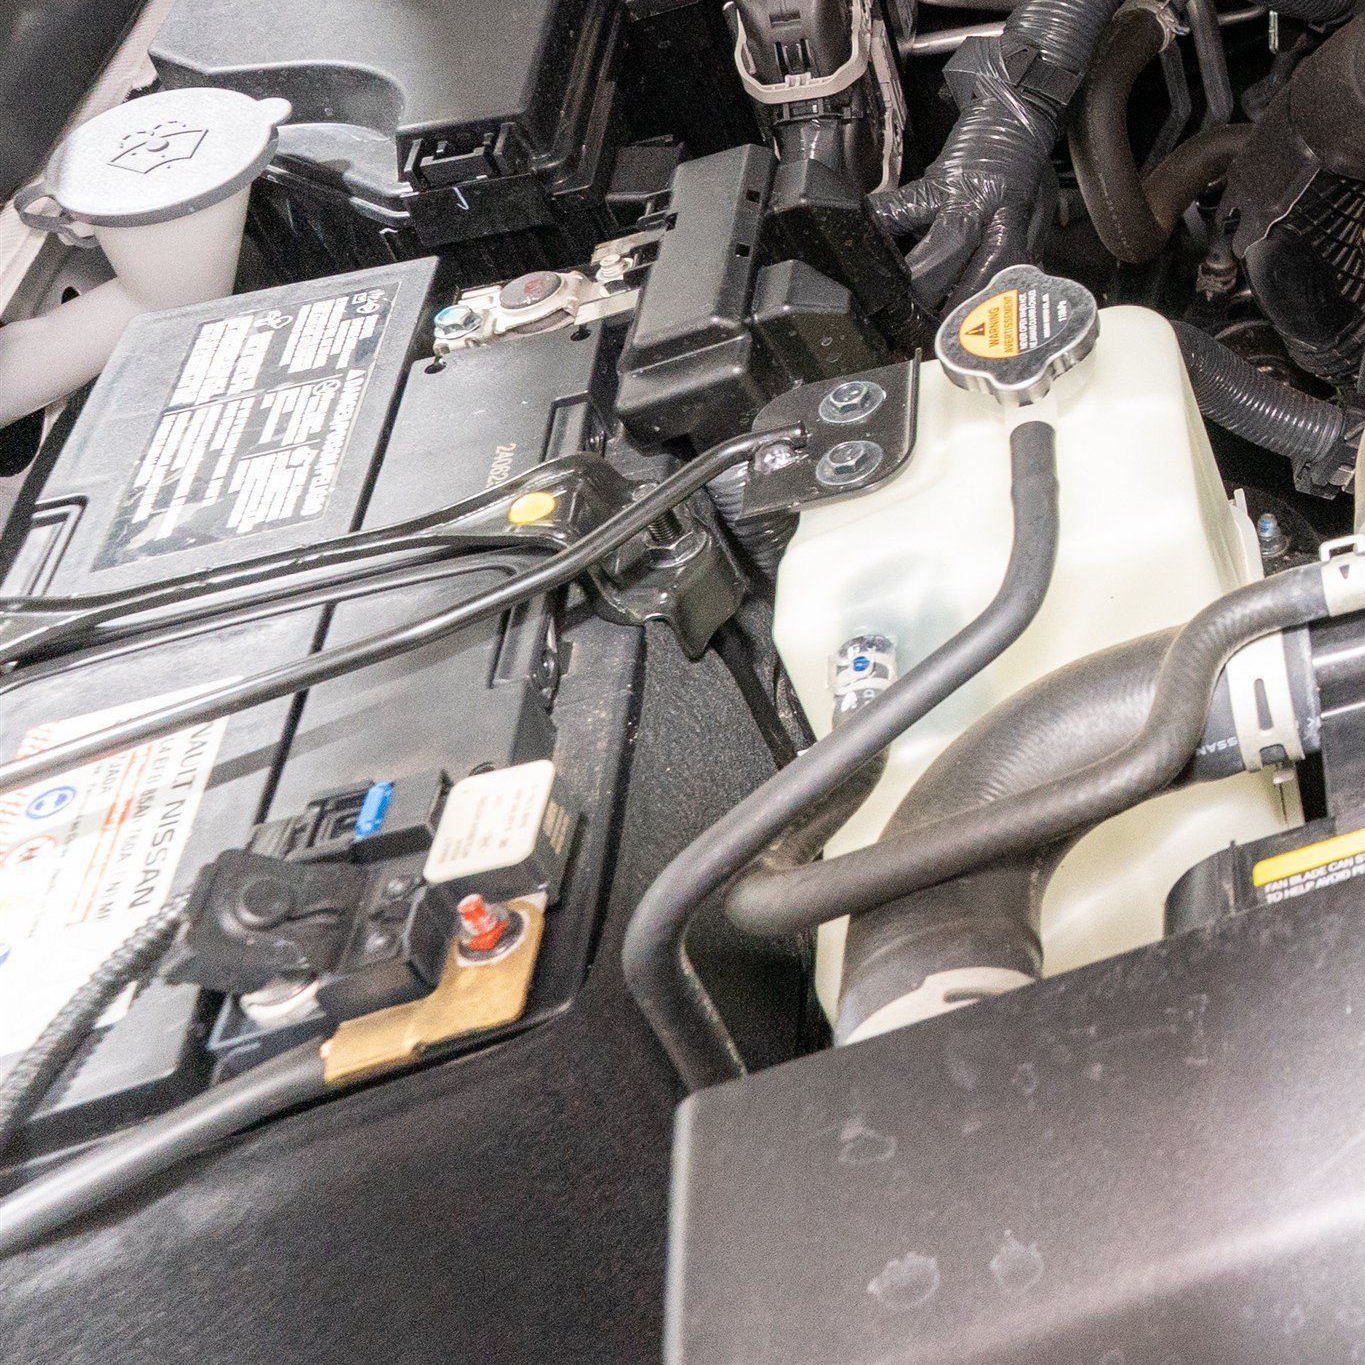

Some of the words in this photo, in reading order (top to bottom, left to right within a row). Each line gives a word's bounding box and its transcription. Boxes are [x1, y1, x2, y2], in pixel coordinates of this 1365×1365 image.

[988, 307, 1000, 348] WARNING
[1003, 296, 1014, 353] AVERTISSEMENT
[171, 721, 214, 790] NAULT
[1196, 736, 1238, 756] SSAN
[127, 798, 187, 910] NISSAN
[1328, 857, 1354, 872] CAN
